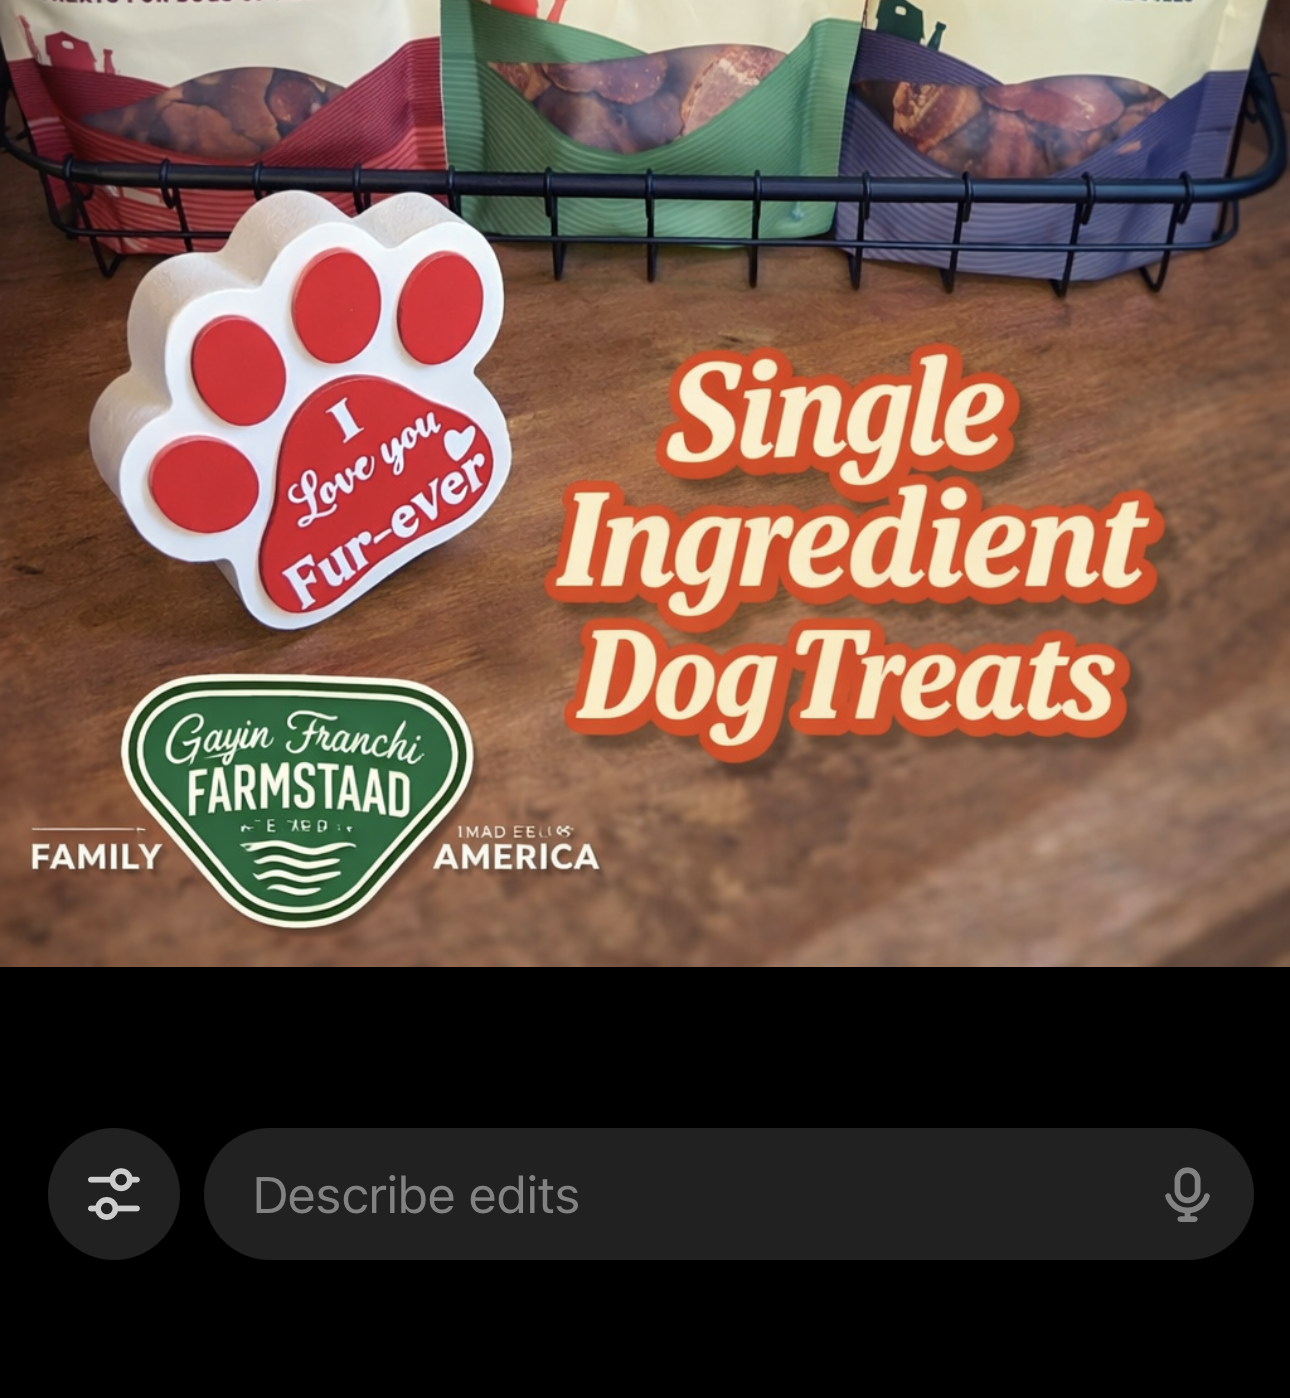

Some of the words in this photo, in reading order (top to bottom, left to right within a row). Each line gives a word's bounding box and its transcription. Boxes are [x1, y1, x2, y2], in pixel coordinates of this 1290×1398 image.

[288, 456, 374, 528] Love
[381, 412, 441, 475] you
[325, 397, 364, 443] I
[282, 453, 485, 610] Fur-ever
